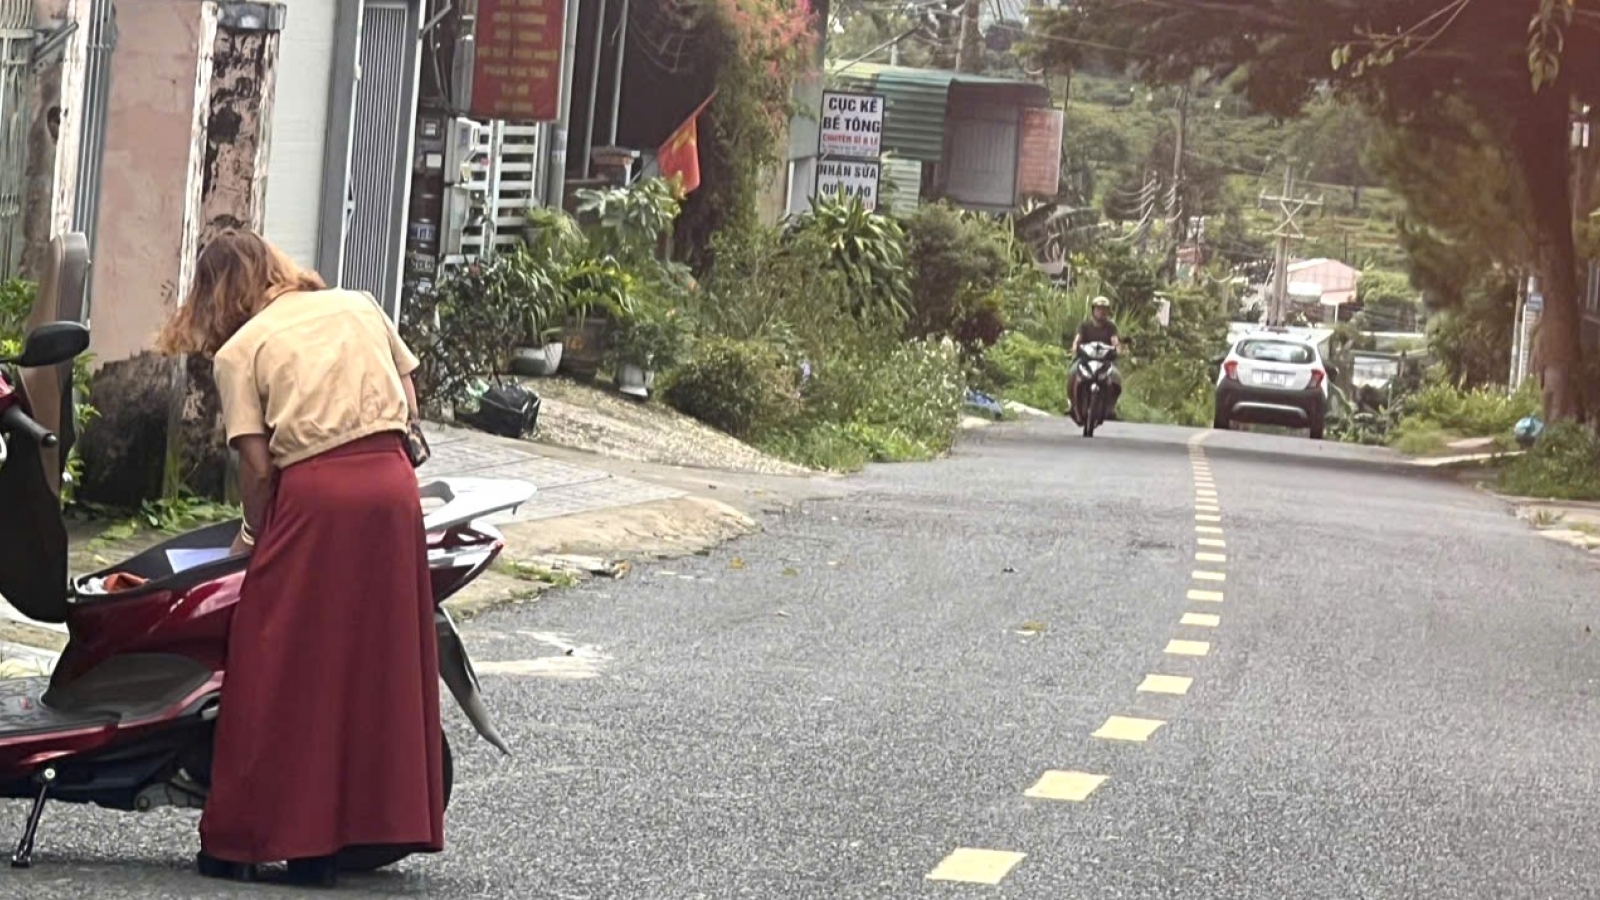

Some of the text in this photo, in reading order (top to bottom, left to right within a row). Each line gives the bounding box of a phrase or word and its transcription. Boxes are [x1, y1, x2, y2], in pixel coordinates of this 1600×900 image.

[829, 97, 856, 114] CỤC
[844, 116, 880, 133] TÔNG
[822, 183, 854, 196] QUN
